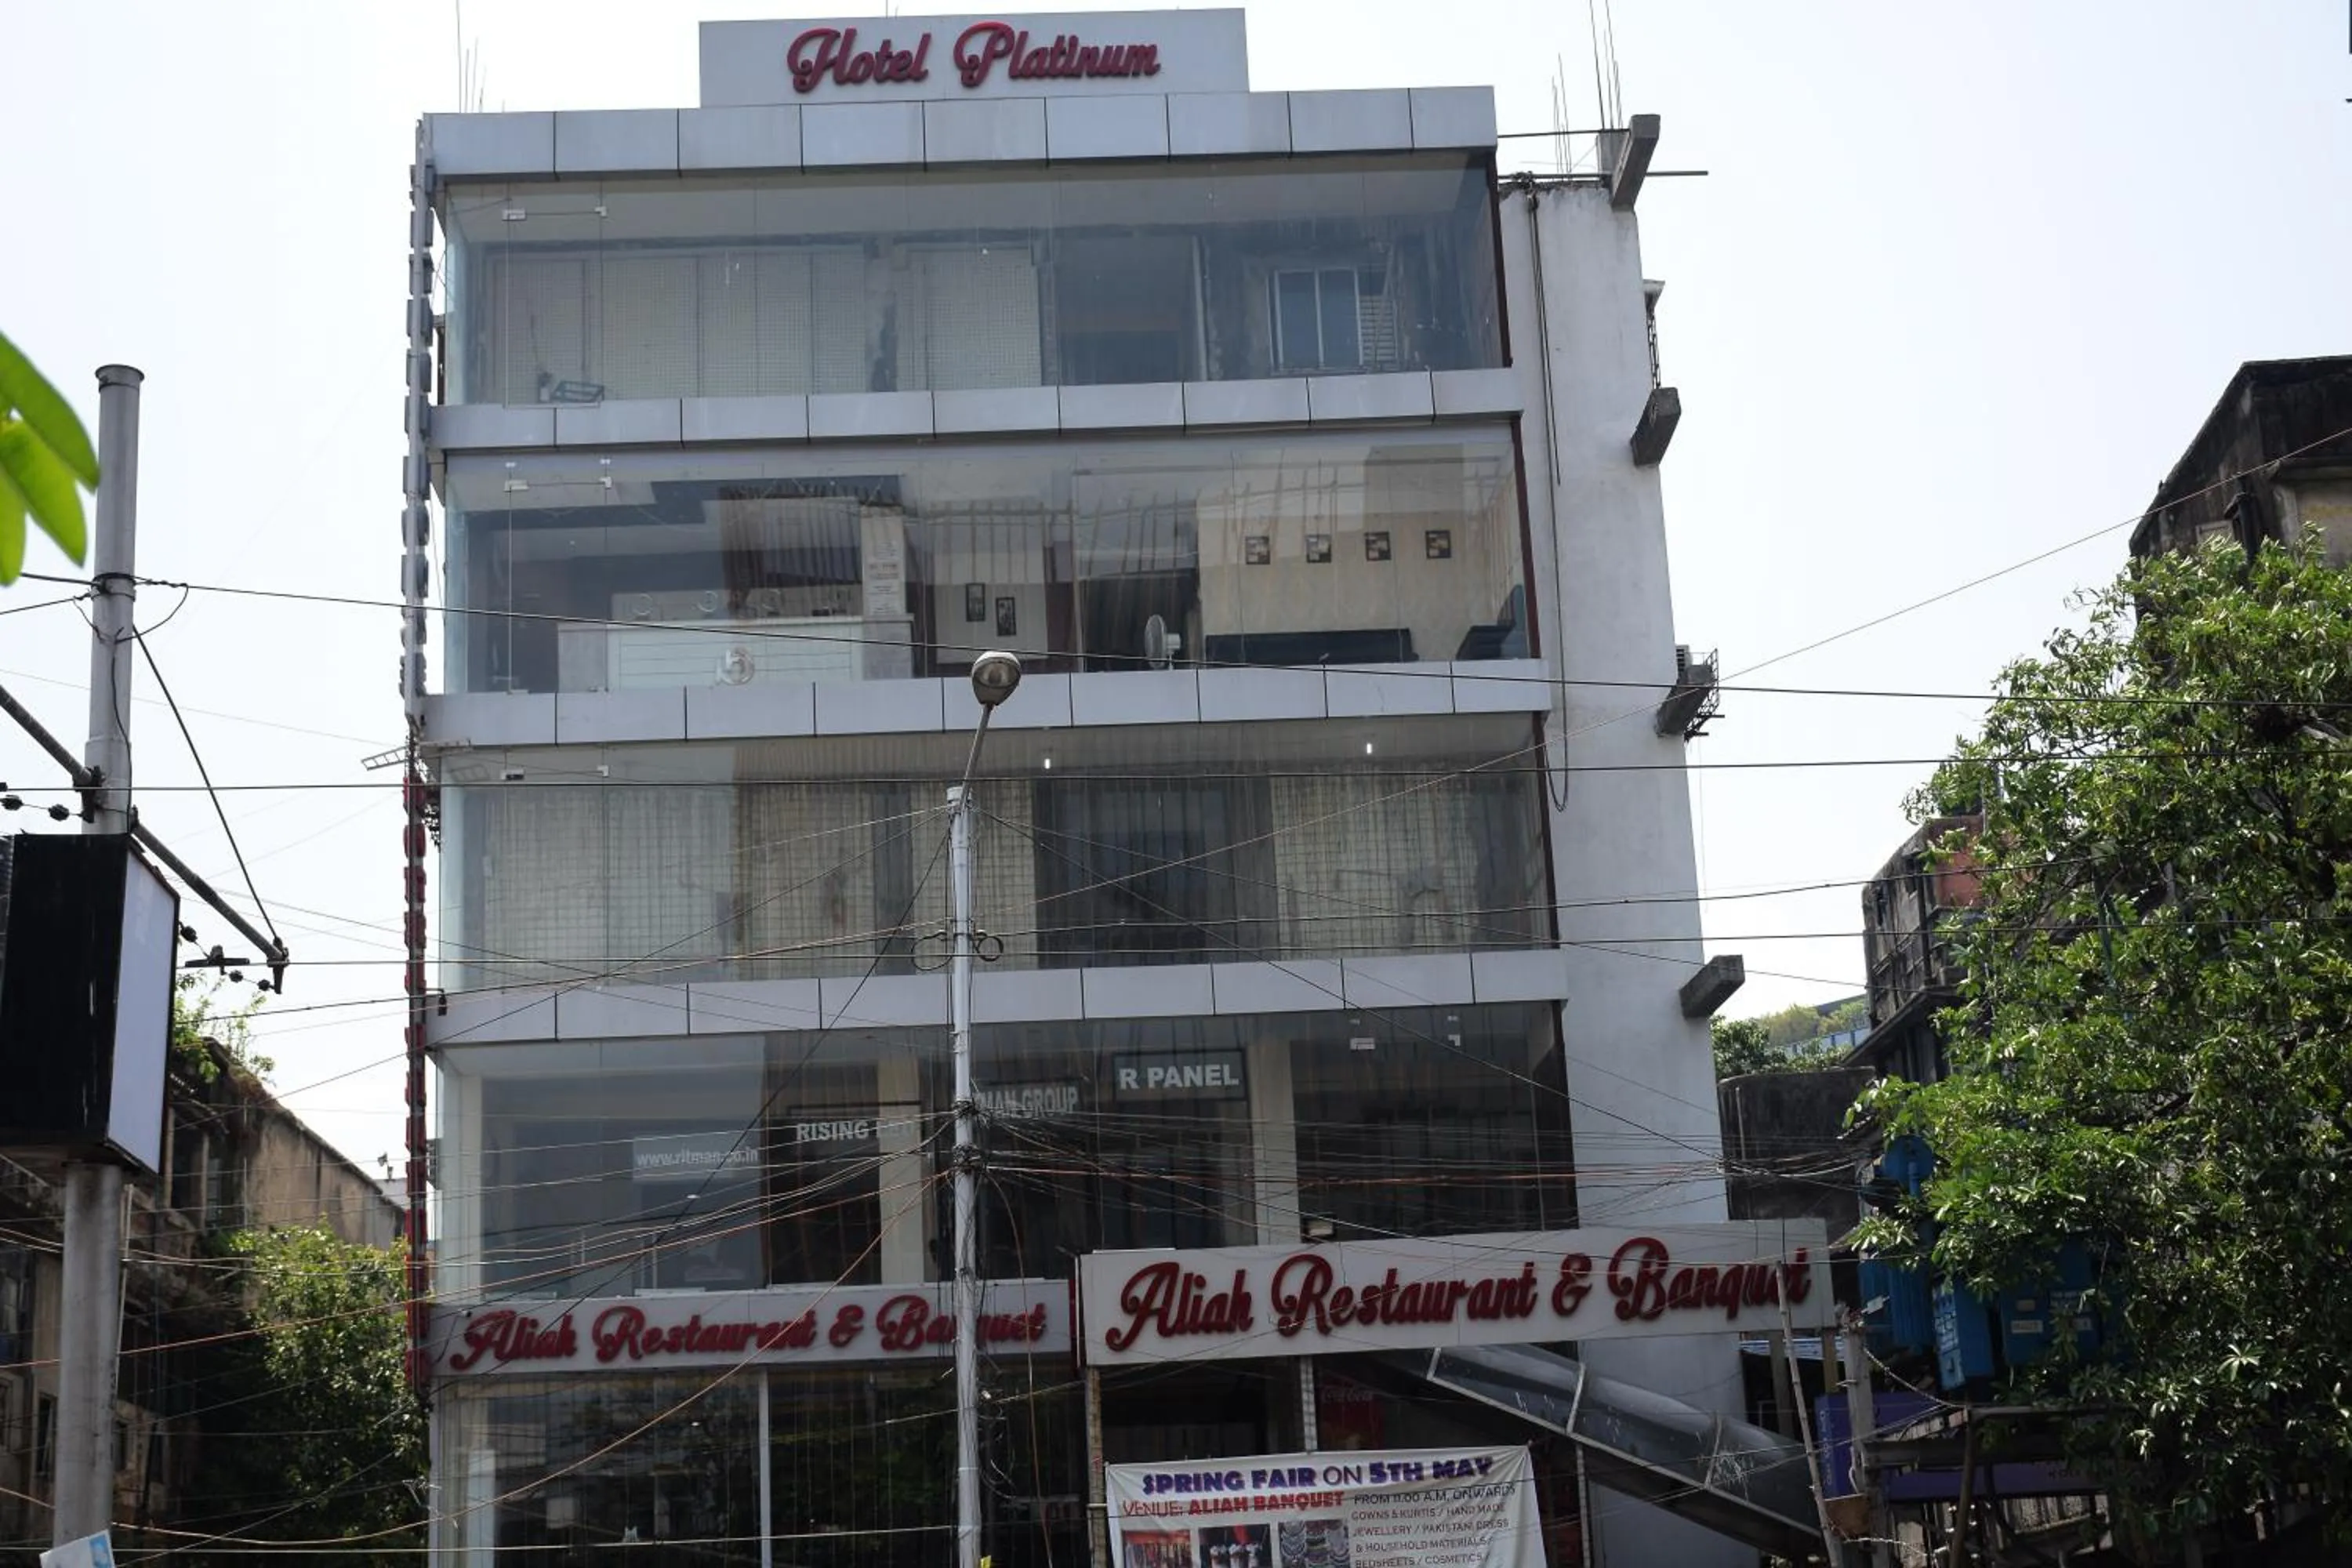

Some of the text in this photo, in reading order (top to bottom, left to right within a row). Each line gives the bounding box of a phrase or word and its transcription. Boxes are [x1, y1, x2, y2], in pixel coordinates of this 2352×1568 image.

[787, 21, 1161, 93] Hotel Platinum
[1118, 1064, 1240, 1090] R PANEL
[1022, 1086, 1079, 1116] GROUP
[797, 1121, 869, 1141] RISING
[1105, 1236, 1812, 1352] Aliah Restaurant & Banquet
[451, 1309, 577, 1370] Aliah
[593, 1305, 816, 1363] Restaurant
[828, 1304, 863, 1345] &
[1142, 1455, 1492, 1495] SPRING FAIR ON 5TH MAY
[1123, 1490, 1345, 1517] VENUE: ALIAH BANQUET
[1354, 1492, 1390, 1504] FROM
[1352, 1510, 1389, 1521] GOWNS
[1366, 1539, 1428, 1552] HOUSEHOLD
